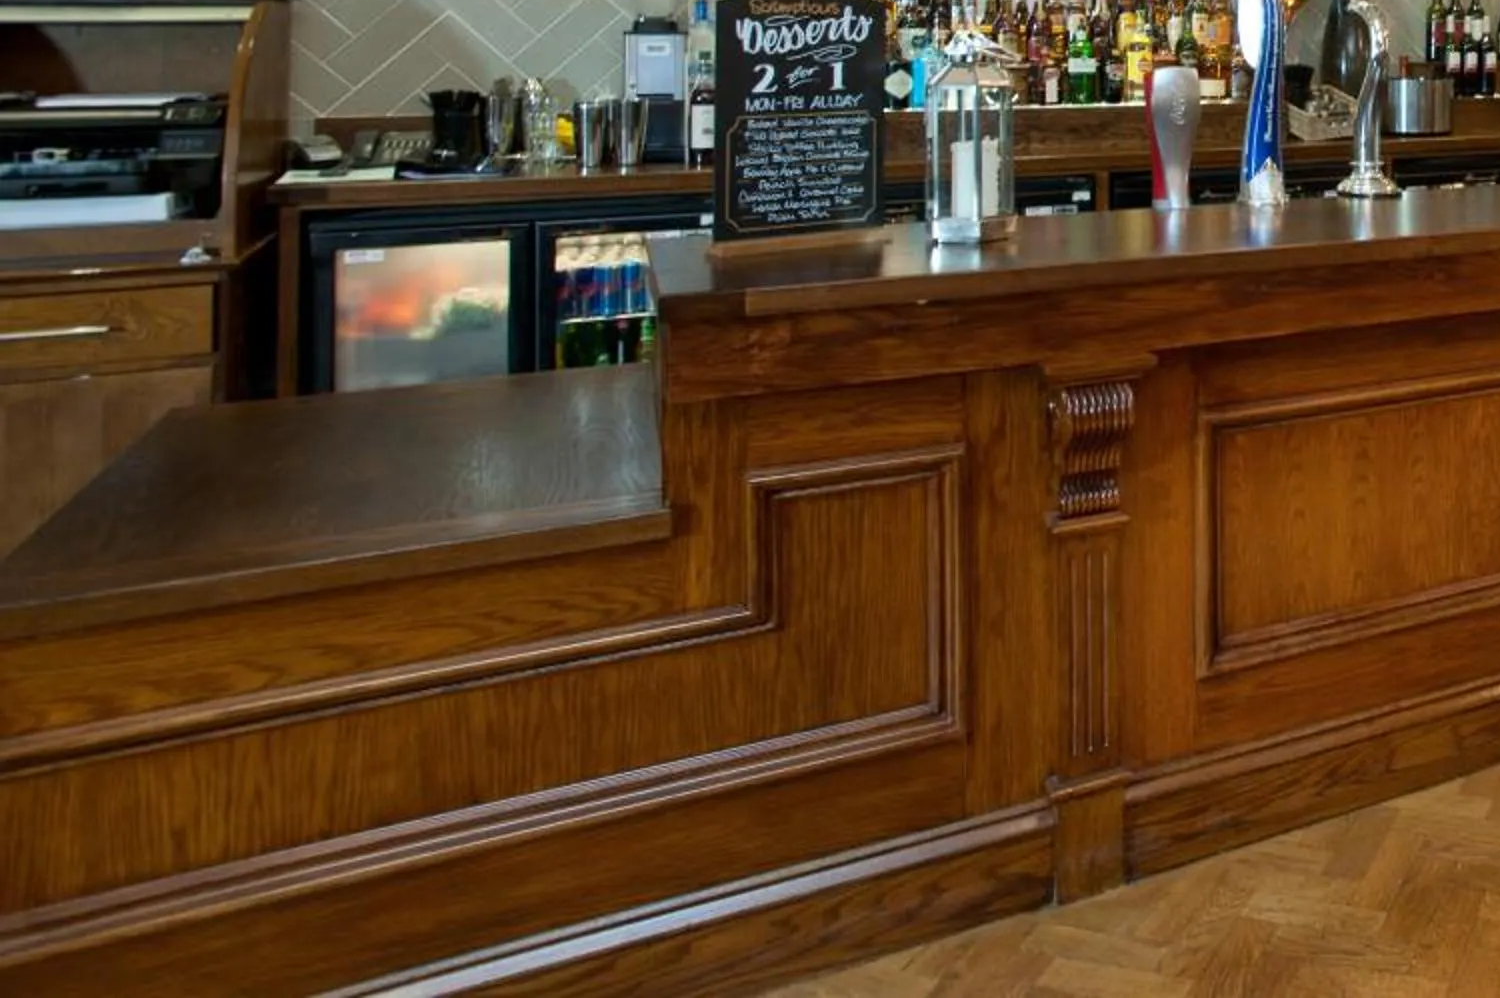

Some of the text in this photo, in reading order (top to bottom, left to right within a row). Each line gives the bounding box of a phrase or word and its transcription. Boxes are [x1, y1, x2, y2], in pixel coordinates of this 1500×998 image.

[735, 5, 873, 55] Desserts
[751, 63, 779, 93] 2
[828, 61, 847, 91] 1
